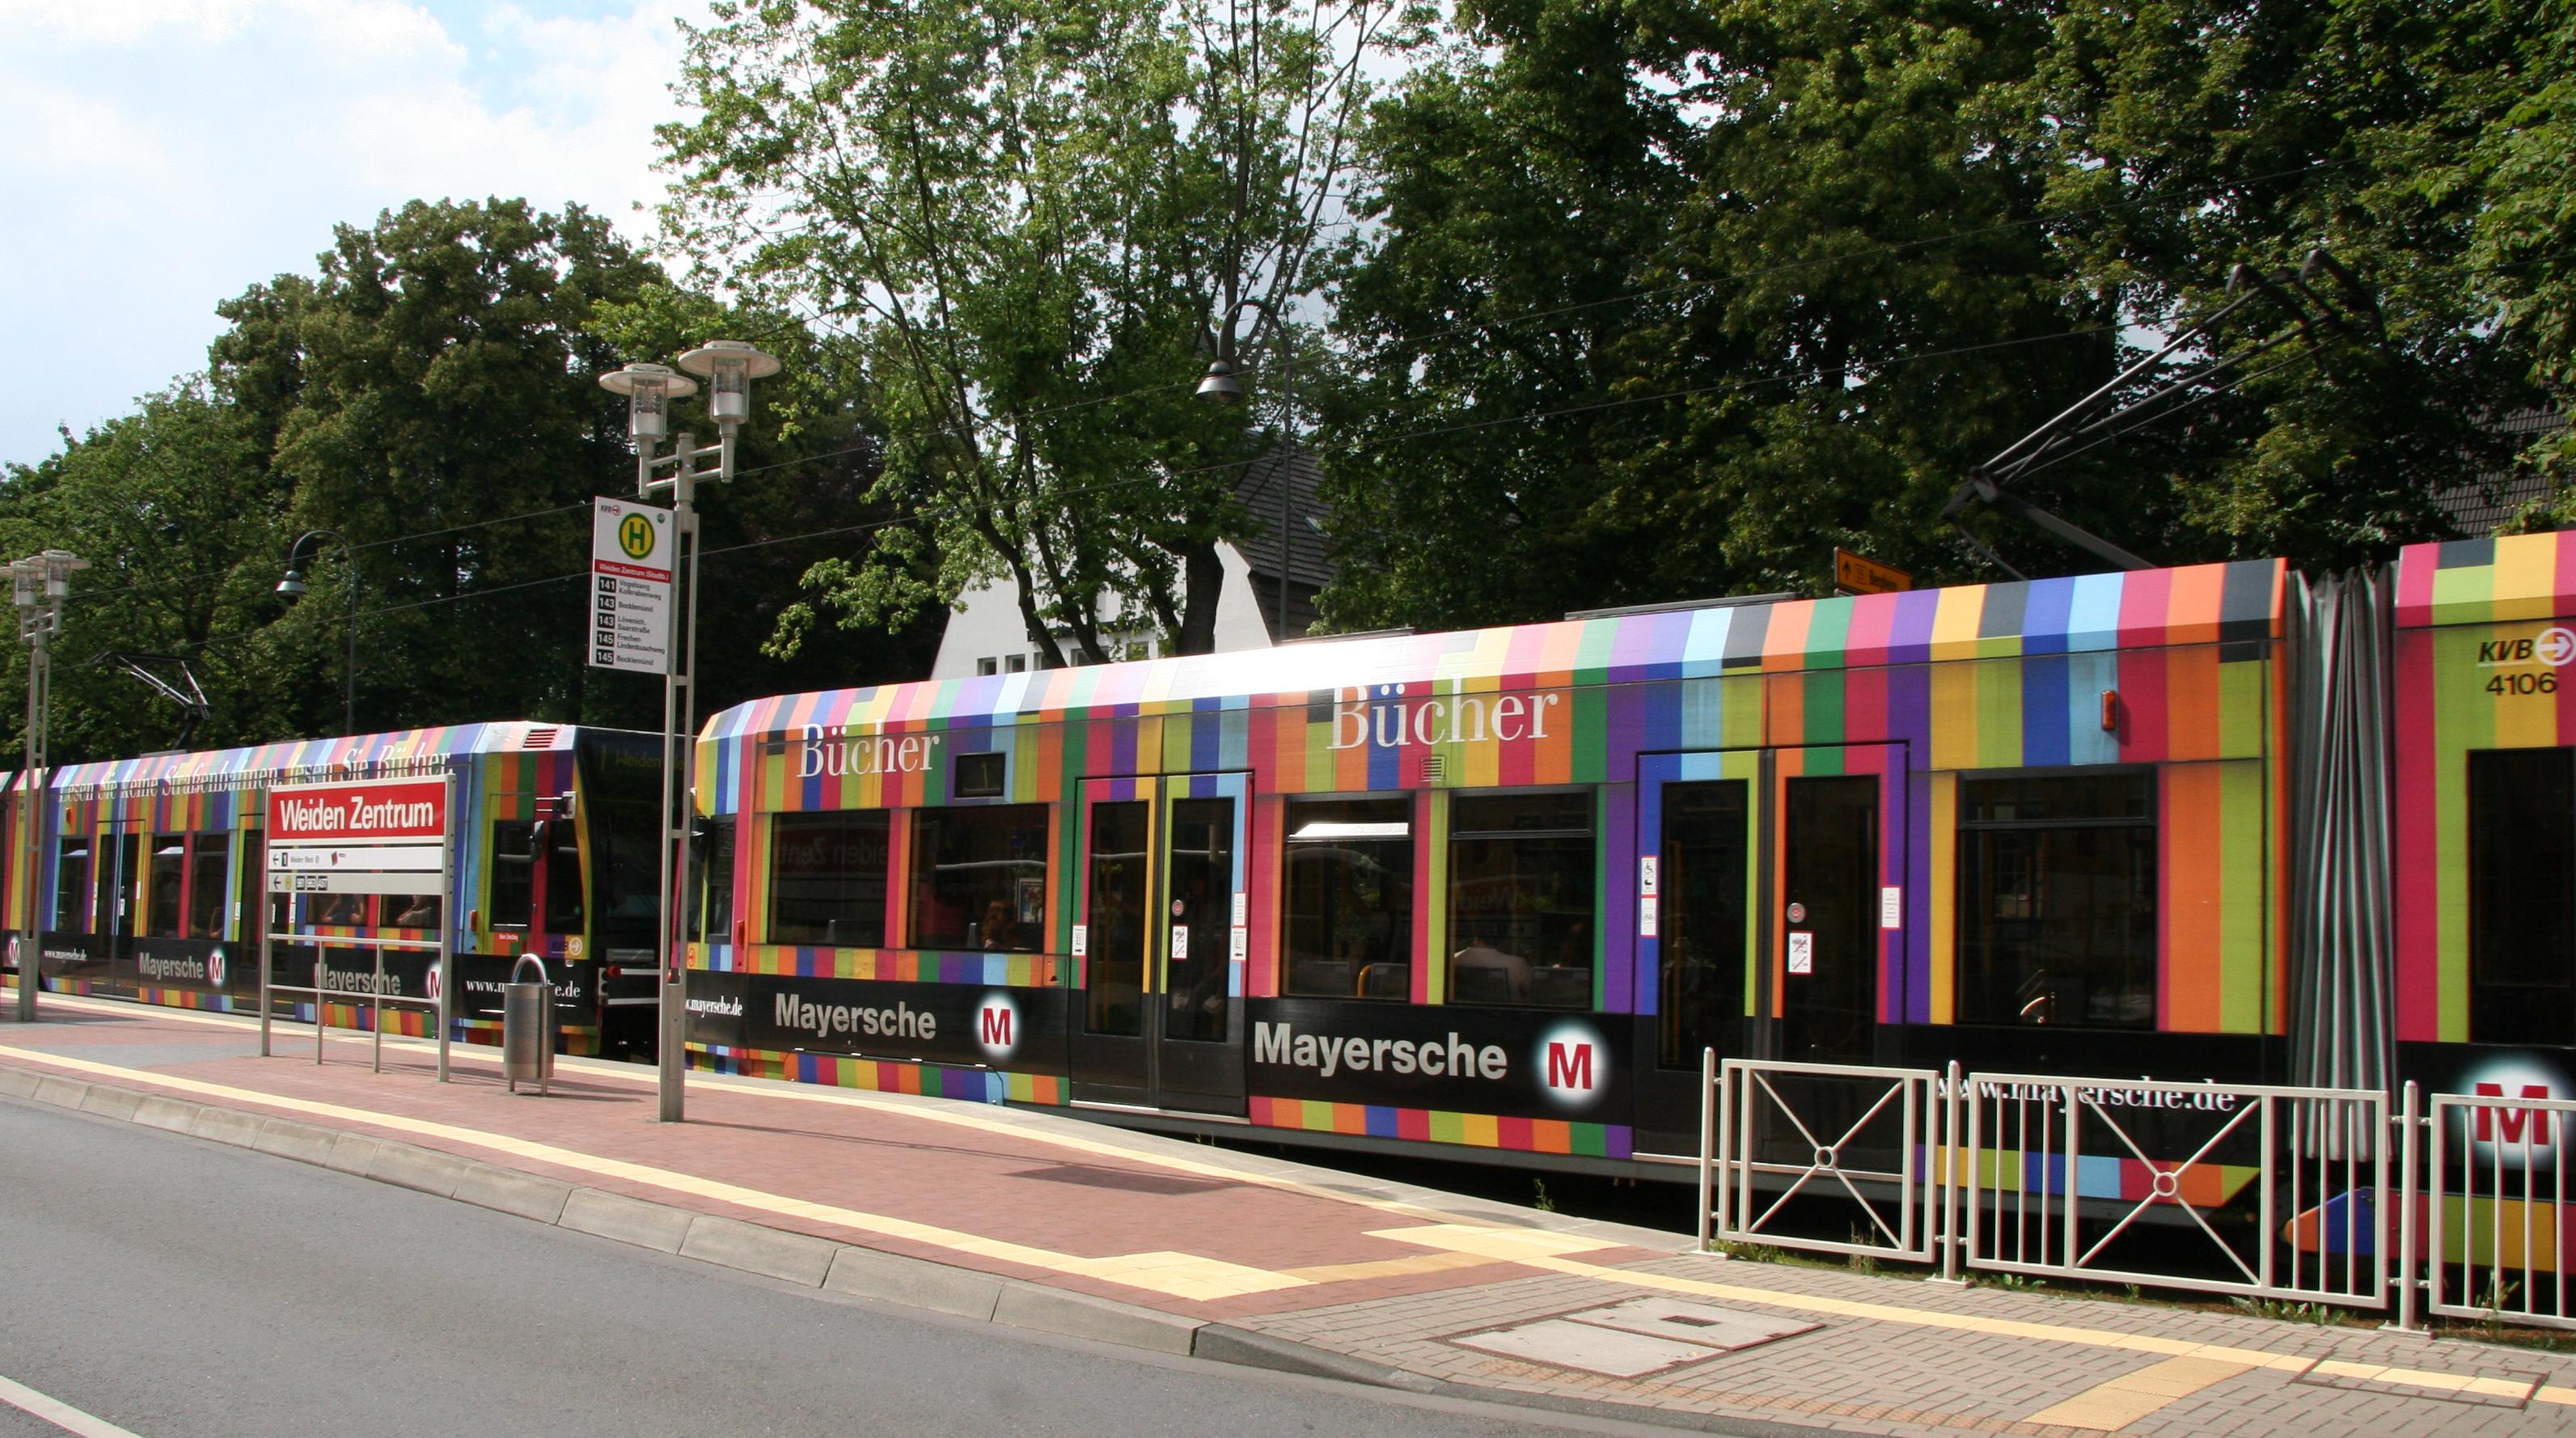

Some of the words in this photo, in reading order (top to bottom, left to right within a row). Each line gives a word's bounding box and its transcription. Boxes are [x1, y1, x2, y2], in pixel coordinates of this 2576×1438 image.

[628, 521, 646, 551] H
[599, 563, 621, 573] Weiden
[621, 566, 646, 577] Zentrum
[600, 579, 615, 590] 141
[620, 580, 650, 591] Vogelsang
[599, 597, 615, 608] 143
[619, 602, 654, 612] Bocklemünd
[599, 615, 615, 626] 143
[618, 624, 650, 634] Saarstraße
[599, 633, 613, 645] 145
[2478, 638, 2534, 662] KVB
[598, 652, 613, 662] 145
[616, 655, 654, 666] Bocklemünd
[2485, 672, 2559, 696] 4106
[1326, 673, 1559, 750] Bücher
[797, 718, 940, 778] Bücher
[57, 774, 95, 803] Lesen
[97, 771, 118, 801] Sie
[121, 768, 158, 799] keine
[288, 754, 333, 784] lesen
[341, 747, 369, 781] Sie
[280, 797, 346, 831] Weiden
[349, 796, 434, 830] Zentrum
[44, 949, 87, 962] www.mayersche.de
[139, 952, 204, 980] Mayersche
[211, 957, 223, 979] M
[685, 996, 742, 1017] .mayersche.de
[775, 993, 937, 1039] Mayersche
[983, 1008, 1012, 1045] M
[1254, 1021, 1508, 1080] Mayersche
[1548, 1042, 1593, 1090] M
[2475, 1082, 2549, 1145] M
